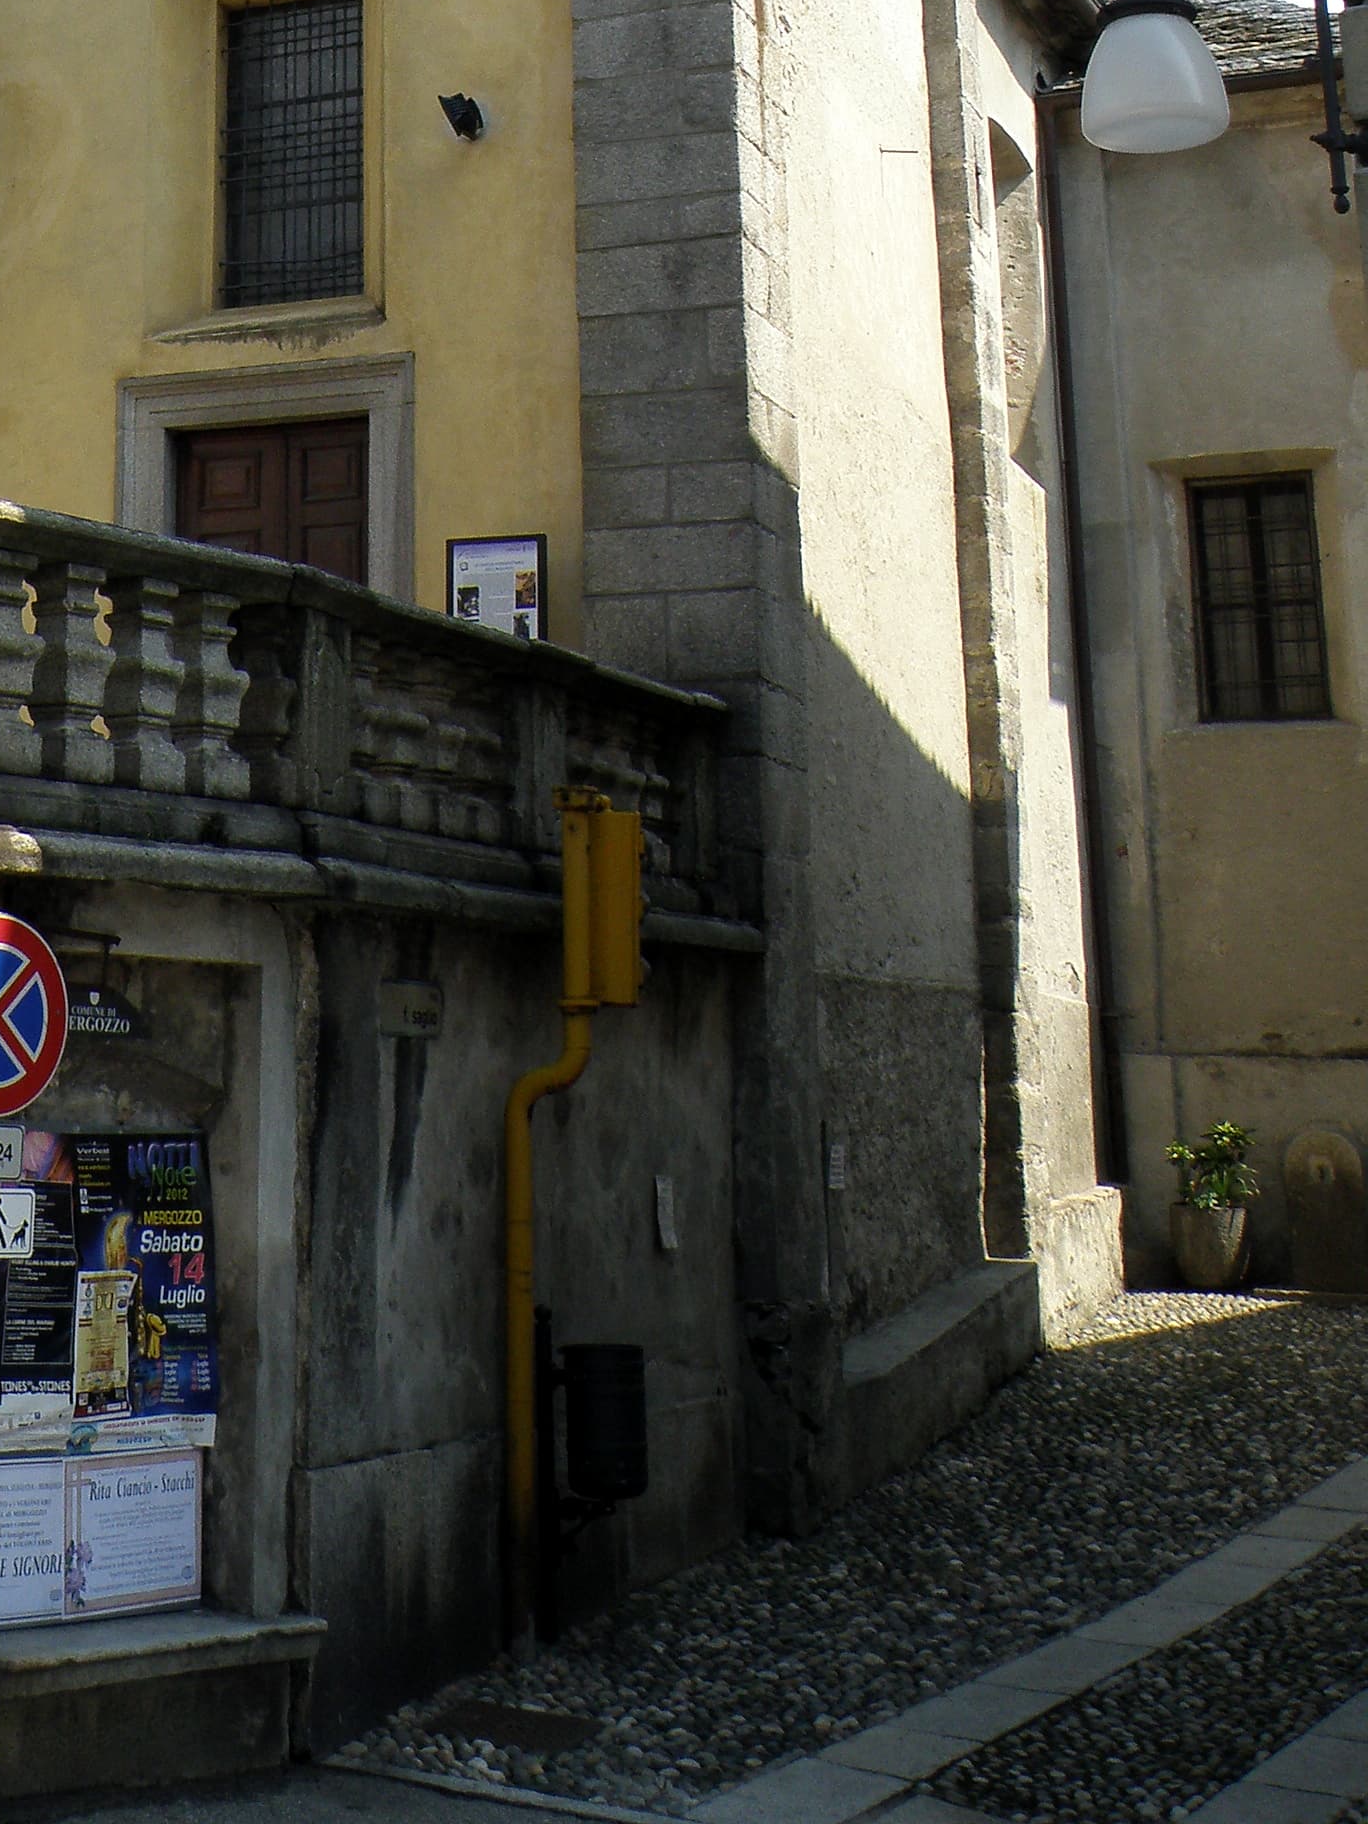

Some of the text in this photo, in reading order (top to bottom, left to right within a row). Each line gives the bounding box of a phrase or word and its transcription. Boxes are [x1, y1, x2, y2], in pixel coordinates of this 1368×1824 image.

[71, 1006, 116, 1017] COMUNE DI
[69, 1017, 131, 1034] ERGOZZO
[166, 1188, 188, 1200] 2012
[144, 1210, 203, 1225] MERGOZZO
[140, 1229, 204, 1253] Sabato
[168, 1253, 205, 1285] 14
[160, 1284, 205, 1308] Luglio
[90, 1480, 111, 1501] Rita
